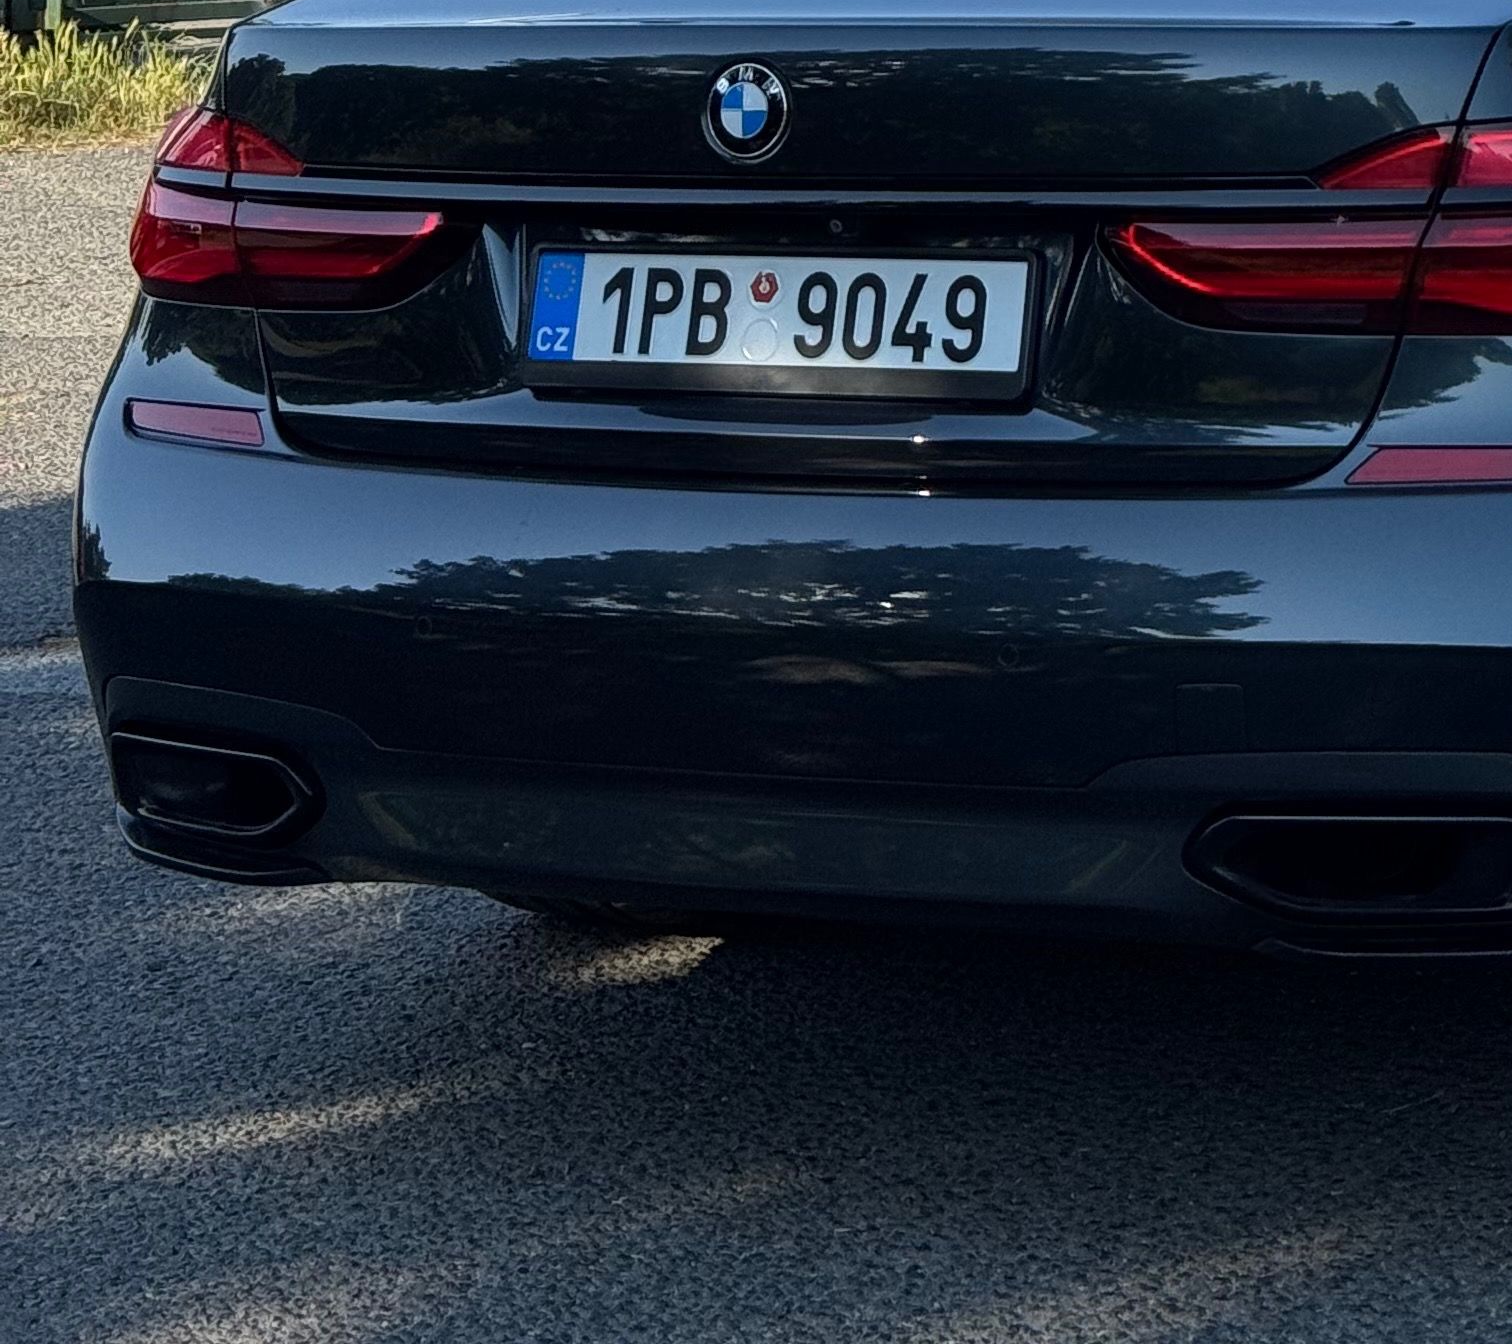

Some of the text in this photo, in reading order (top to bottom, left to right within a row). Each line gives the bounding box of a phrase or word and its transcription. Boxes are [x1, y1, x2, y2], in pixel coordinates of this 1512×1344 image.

[716, 66, 781, 102] BMW
[602, 267, 988, 364] 1PB 9049
[535, 326, 570, 353] CZ
